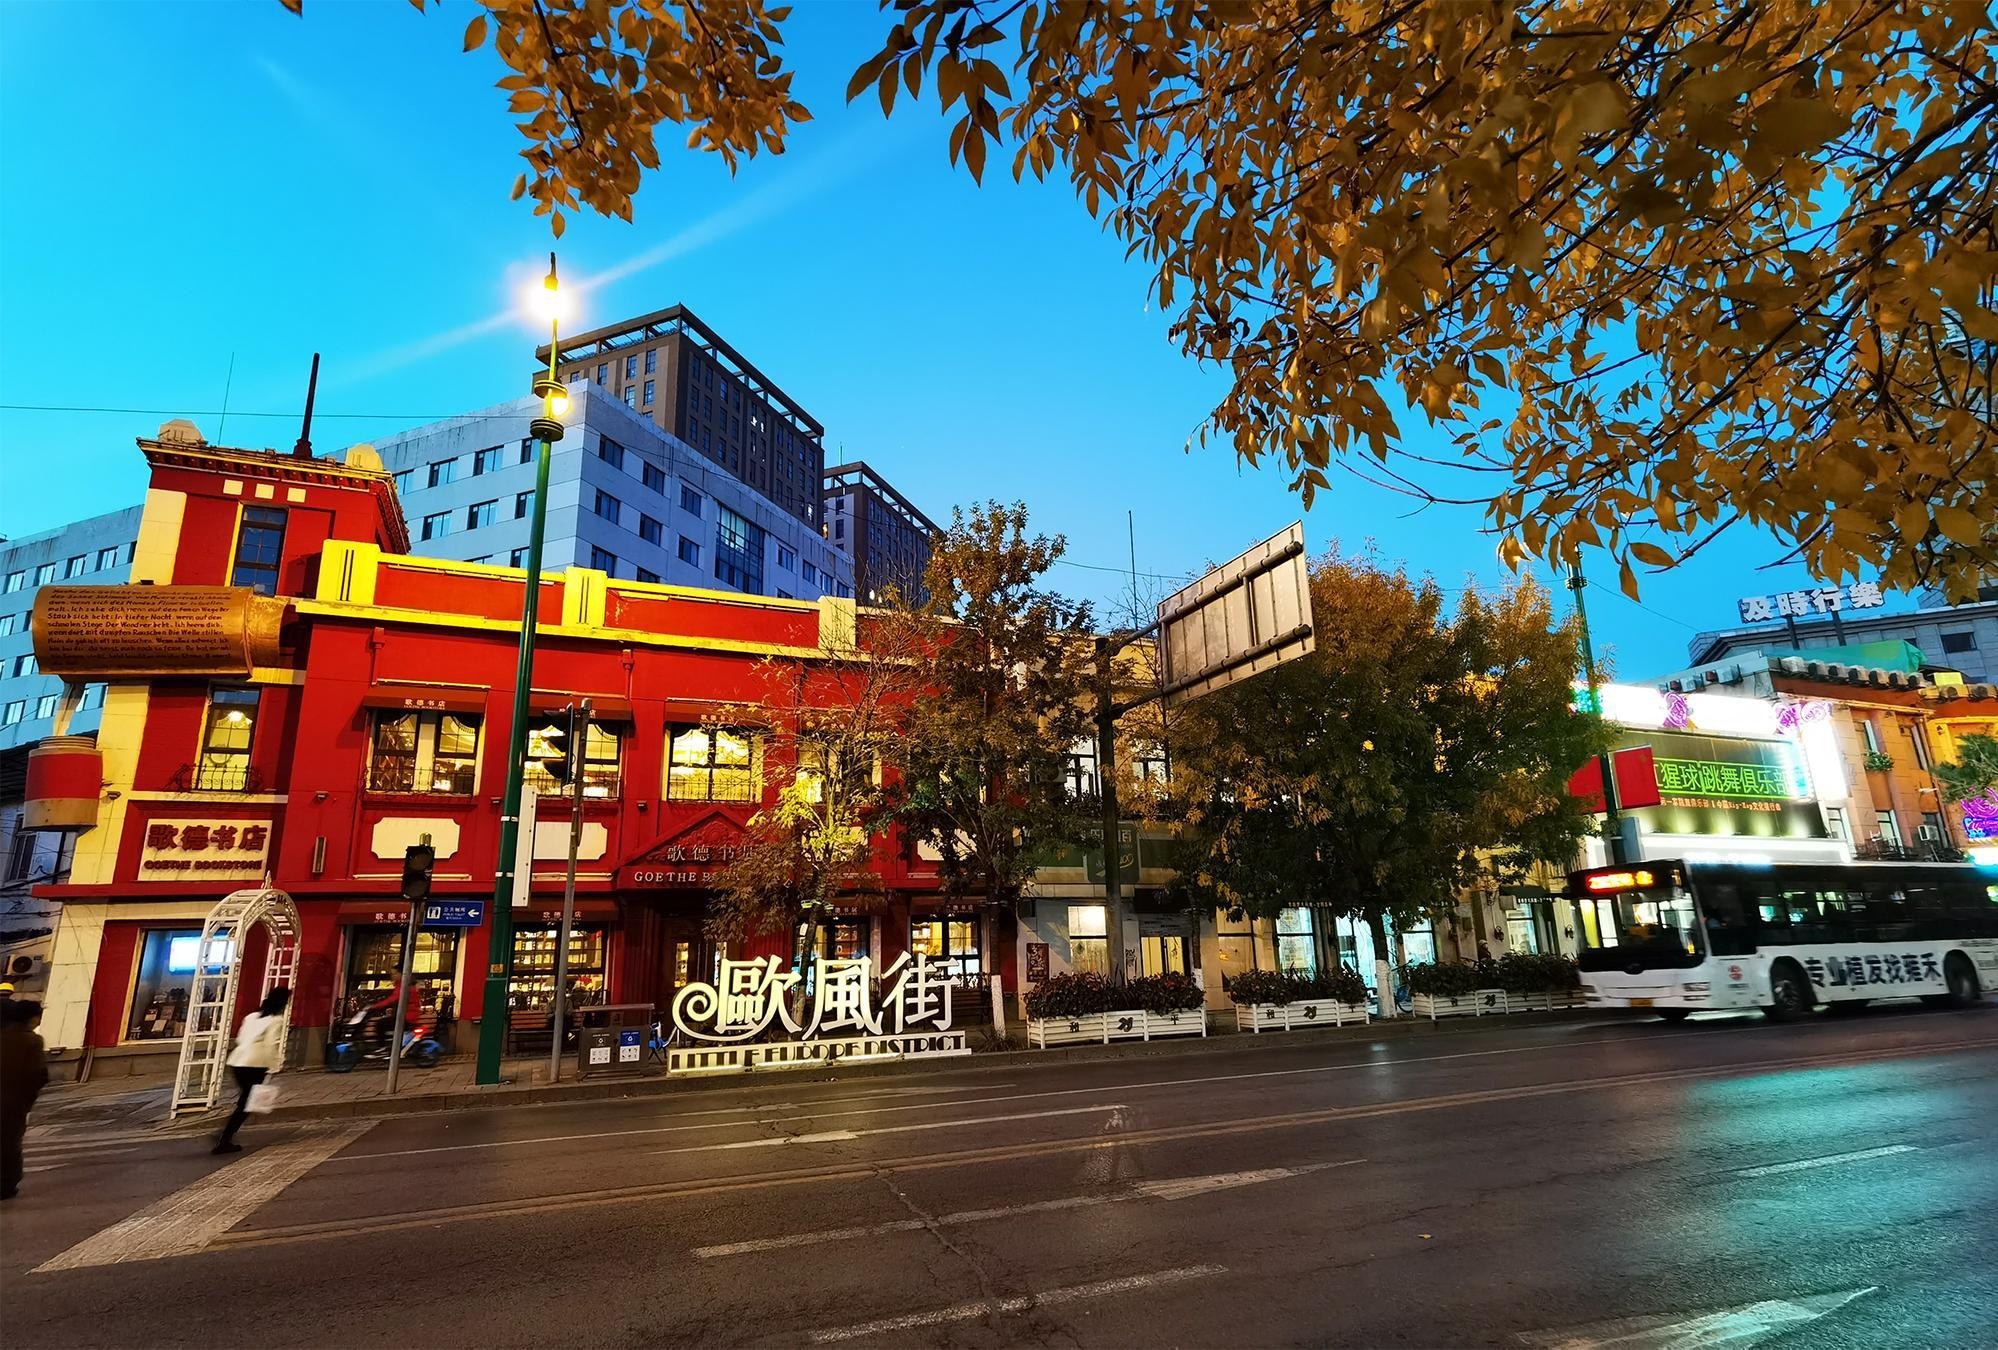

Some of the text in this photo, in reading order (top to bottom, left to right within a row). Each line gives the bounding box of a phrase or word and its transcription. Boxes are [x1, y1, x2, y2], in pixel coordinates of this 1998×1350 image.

[1742, 582, 1884, 621] 及時行樂
[147, 824, 268, 851] 歌德书店
[143, 860, 263, 870] GOETHE BOOKSTORE
[634, 872, 697, 882] GOETHE
[672, 950, 962, 1041] 歐風街
[670, 1035, 965, 1069] LITTLE EUROPE DISTRICT
